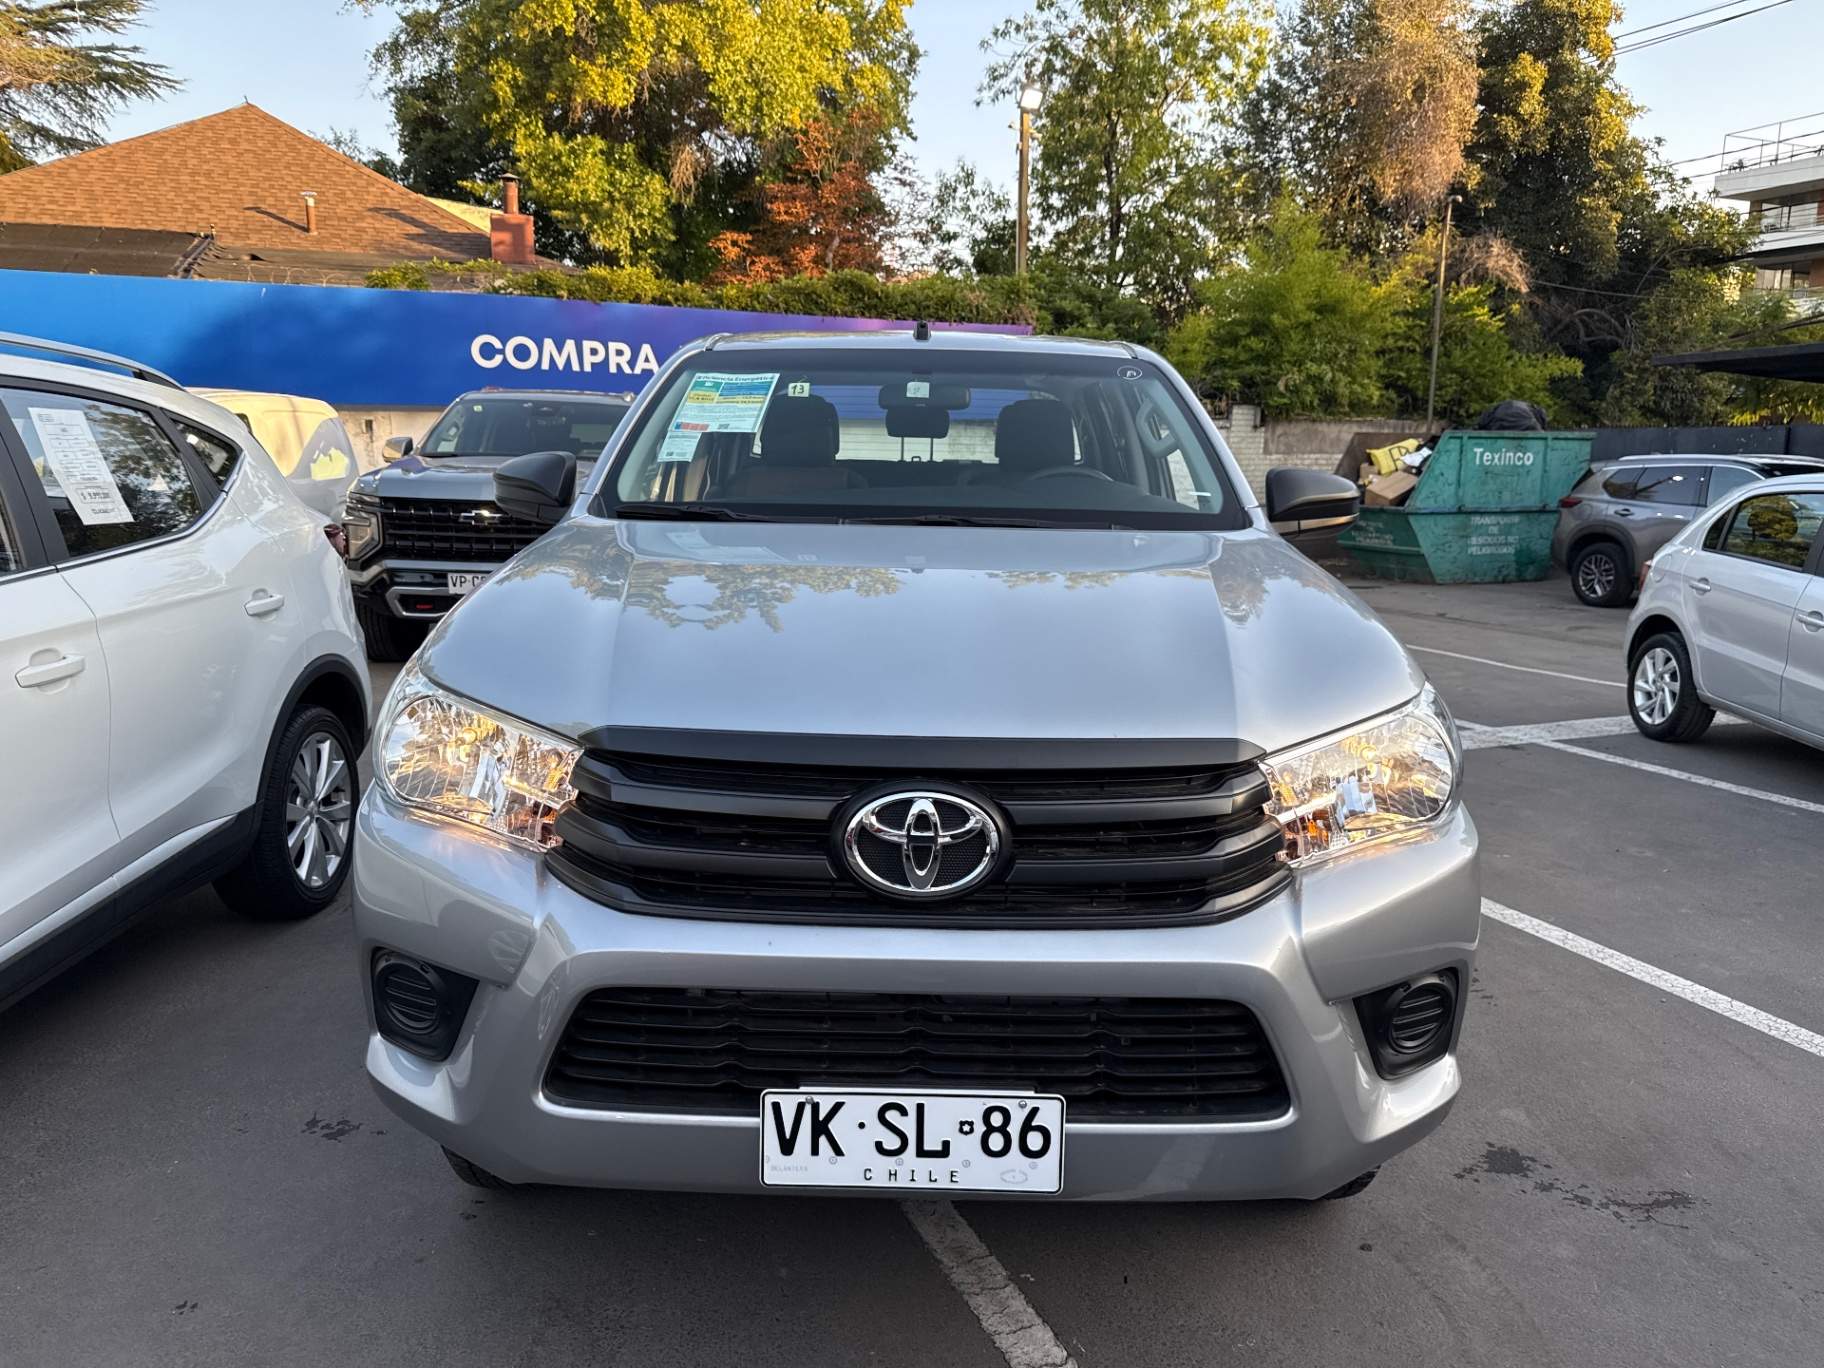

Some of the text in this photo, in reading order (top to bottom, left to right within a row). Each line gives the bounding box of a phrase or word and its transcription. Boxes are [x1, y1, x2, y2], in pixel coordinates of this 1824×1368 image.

[471, 334, 660, 374] COMPRA
[791, 385, 805, 395] 13
[1474, 448, 1534, 465] Texinco
[864, 1168, 959, 1183] CHILE
